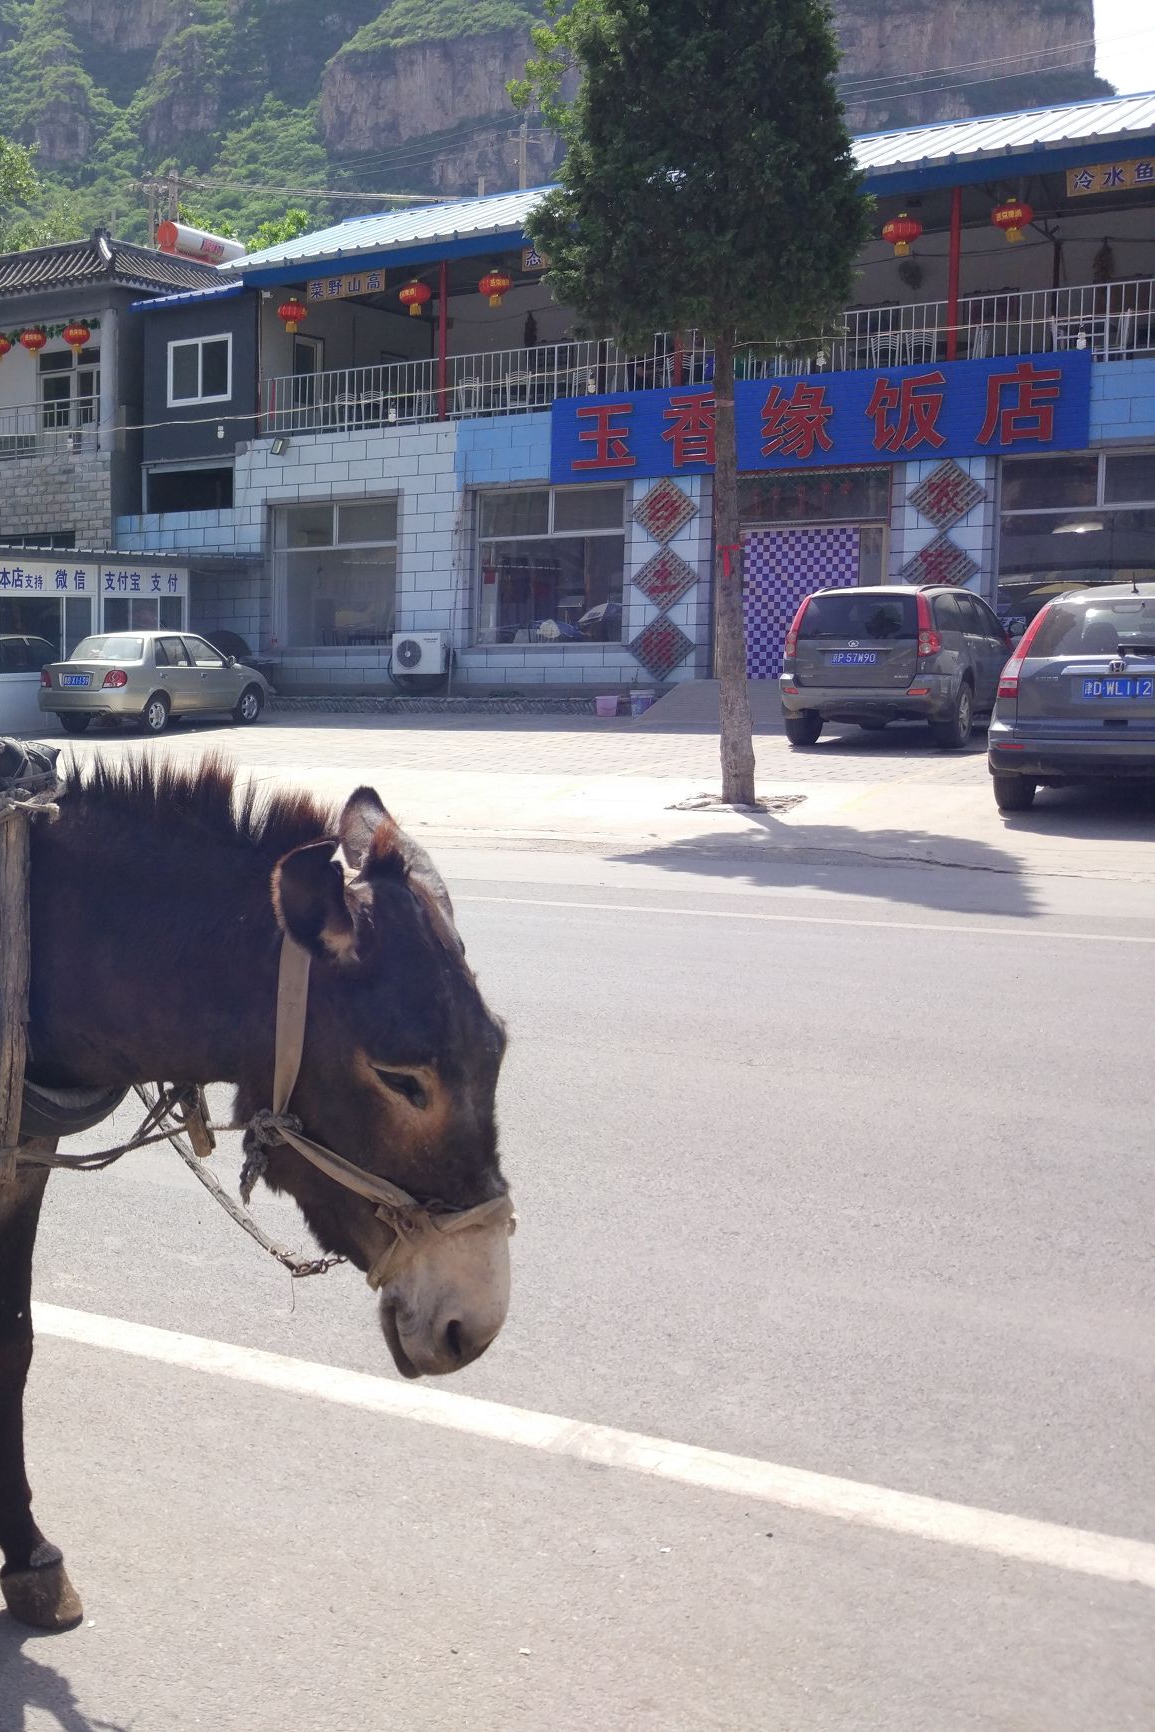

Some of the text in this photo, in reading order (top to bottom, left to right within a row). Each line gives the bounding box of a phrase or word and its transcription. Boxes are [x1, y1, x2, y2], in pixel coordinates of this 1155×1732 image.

[1073, 161, 1155, 191] 冷水鱼
[570, 362, 1063, 472] 玉香缘饭店
[55, 568, 86, 591] 微信
[104, 571, 178, 593] 支付宝 支付
